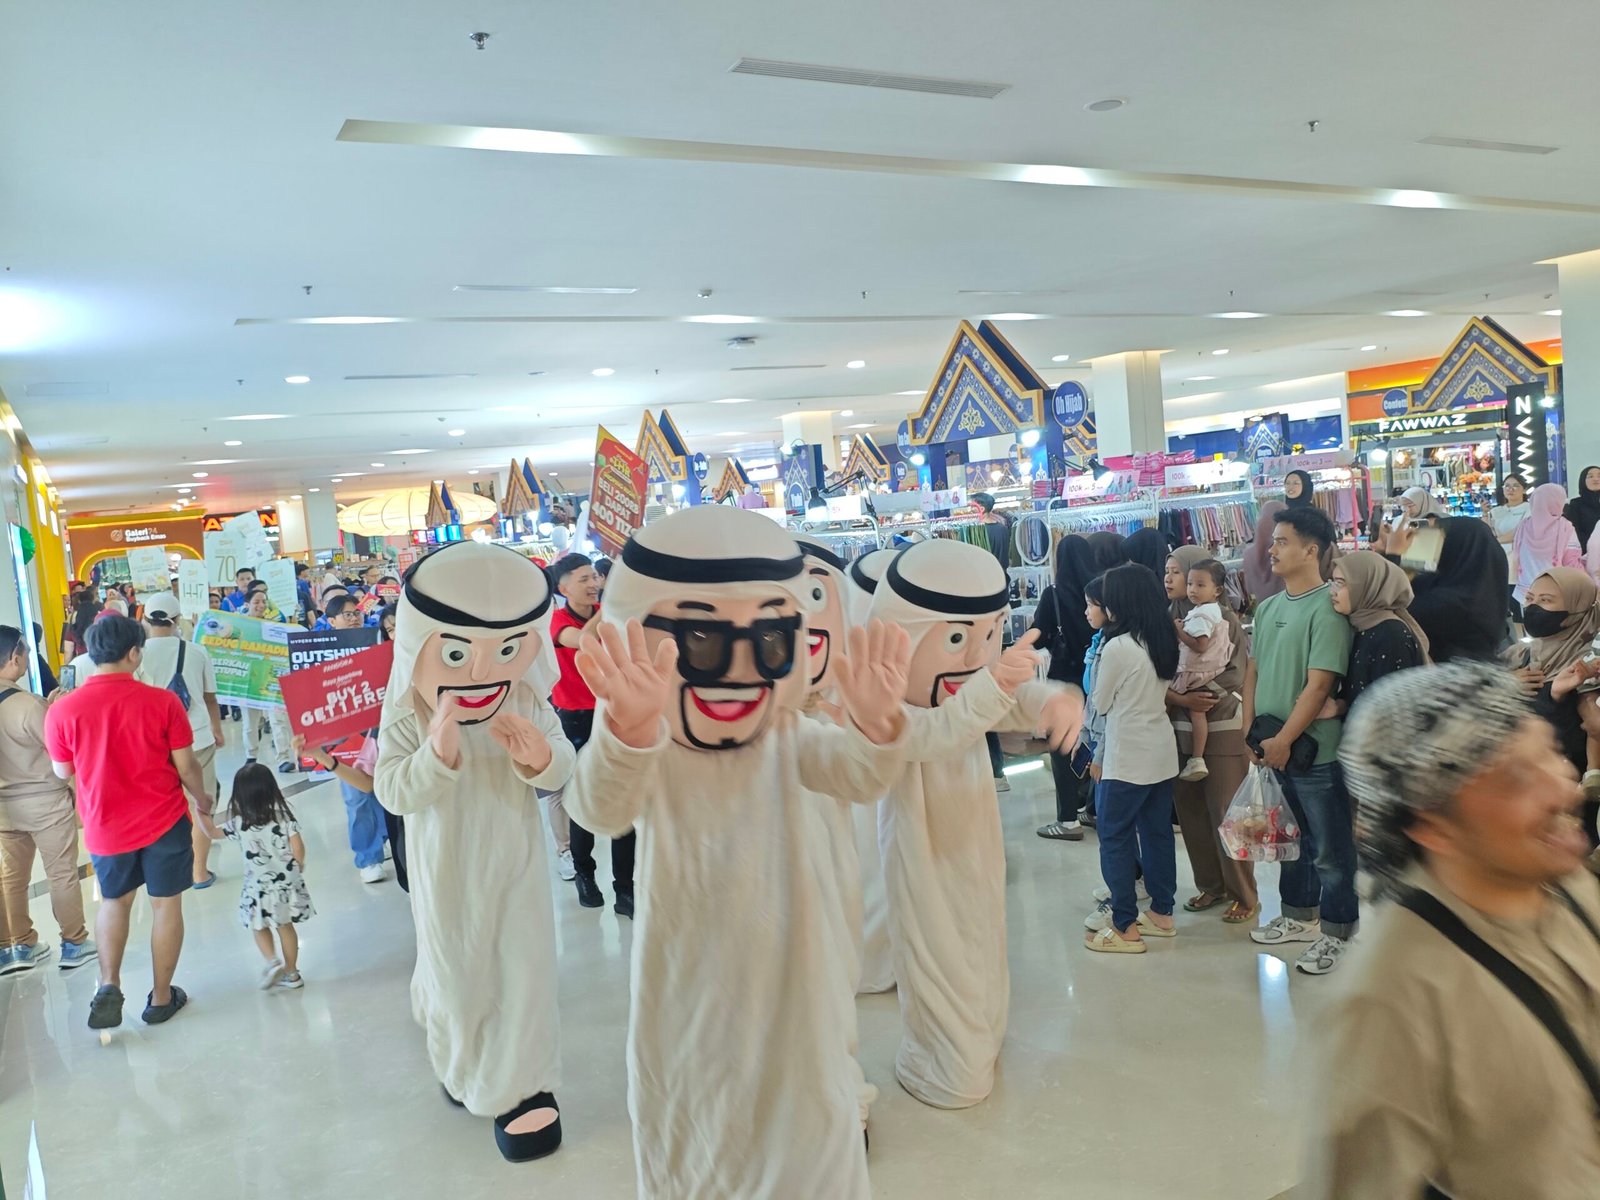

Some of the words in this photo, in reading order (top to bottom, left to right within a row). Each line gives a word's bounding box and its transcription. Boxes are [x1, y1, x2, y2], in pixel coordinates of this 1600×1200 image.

[1055, 396, 1065, 415] Oh
[1065, 393, 1083, 414] Hijab
[1378, 413, 1468, 433] FAWWAZ
[599, 477, 615, 497] BELI
[605, 496, 632, 520] DAPAT
[592, 501, 614, 525] 400
[615, 515, 633, 538] TIZ
[125, 528, 148, 537] Galeri
[215, 555, 236, 582] 70
[241, 641, 289, 657] RAMADH
[292, 646, 370, 664] OUTSHIN
[214, 667, 248, 677] ETUPAT
[327, 684, 357, 707] BUY
[360, 680, 371, 695] 2
[301, 703, 334, 727] GET
[353, 686, 386, 709] FRE
